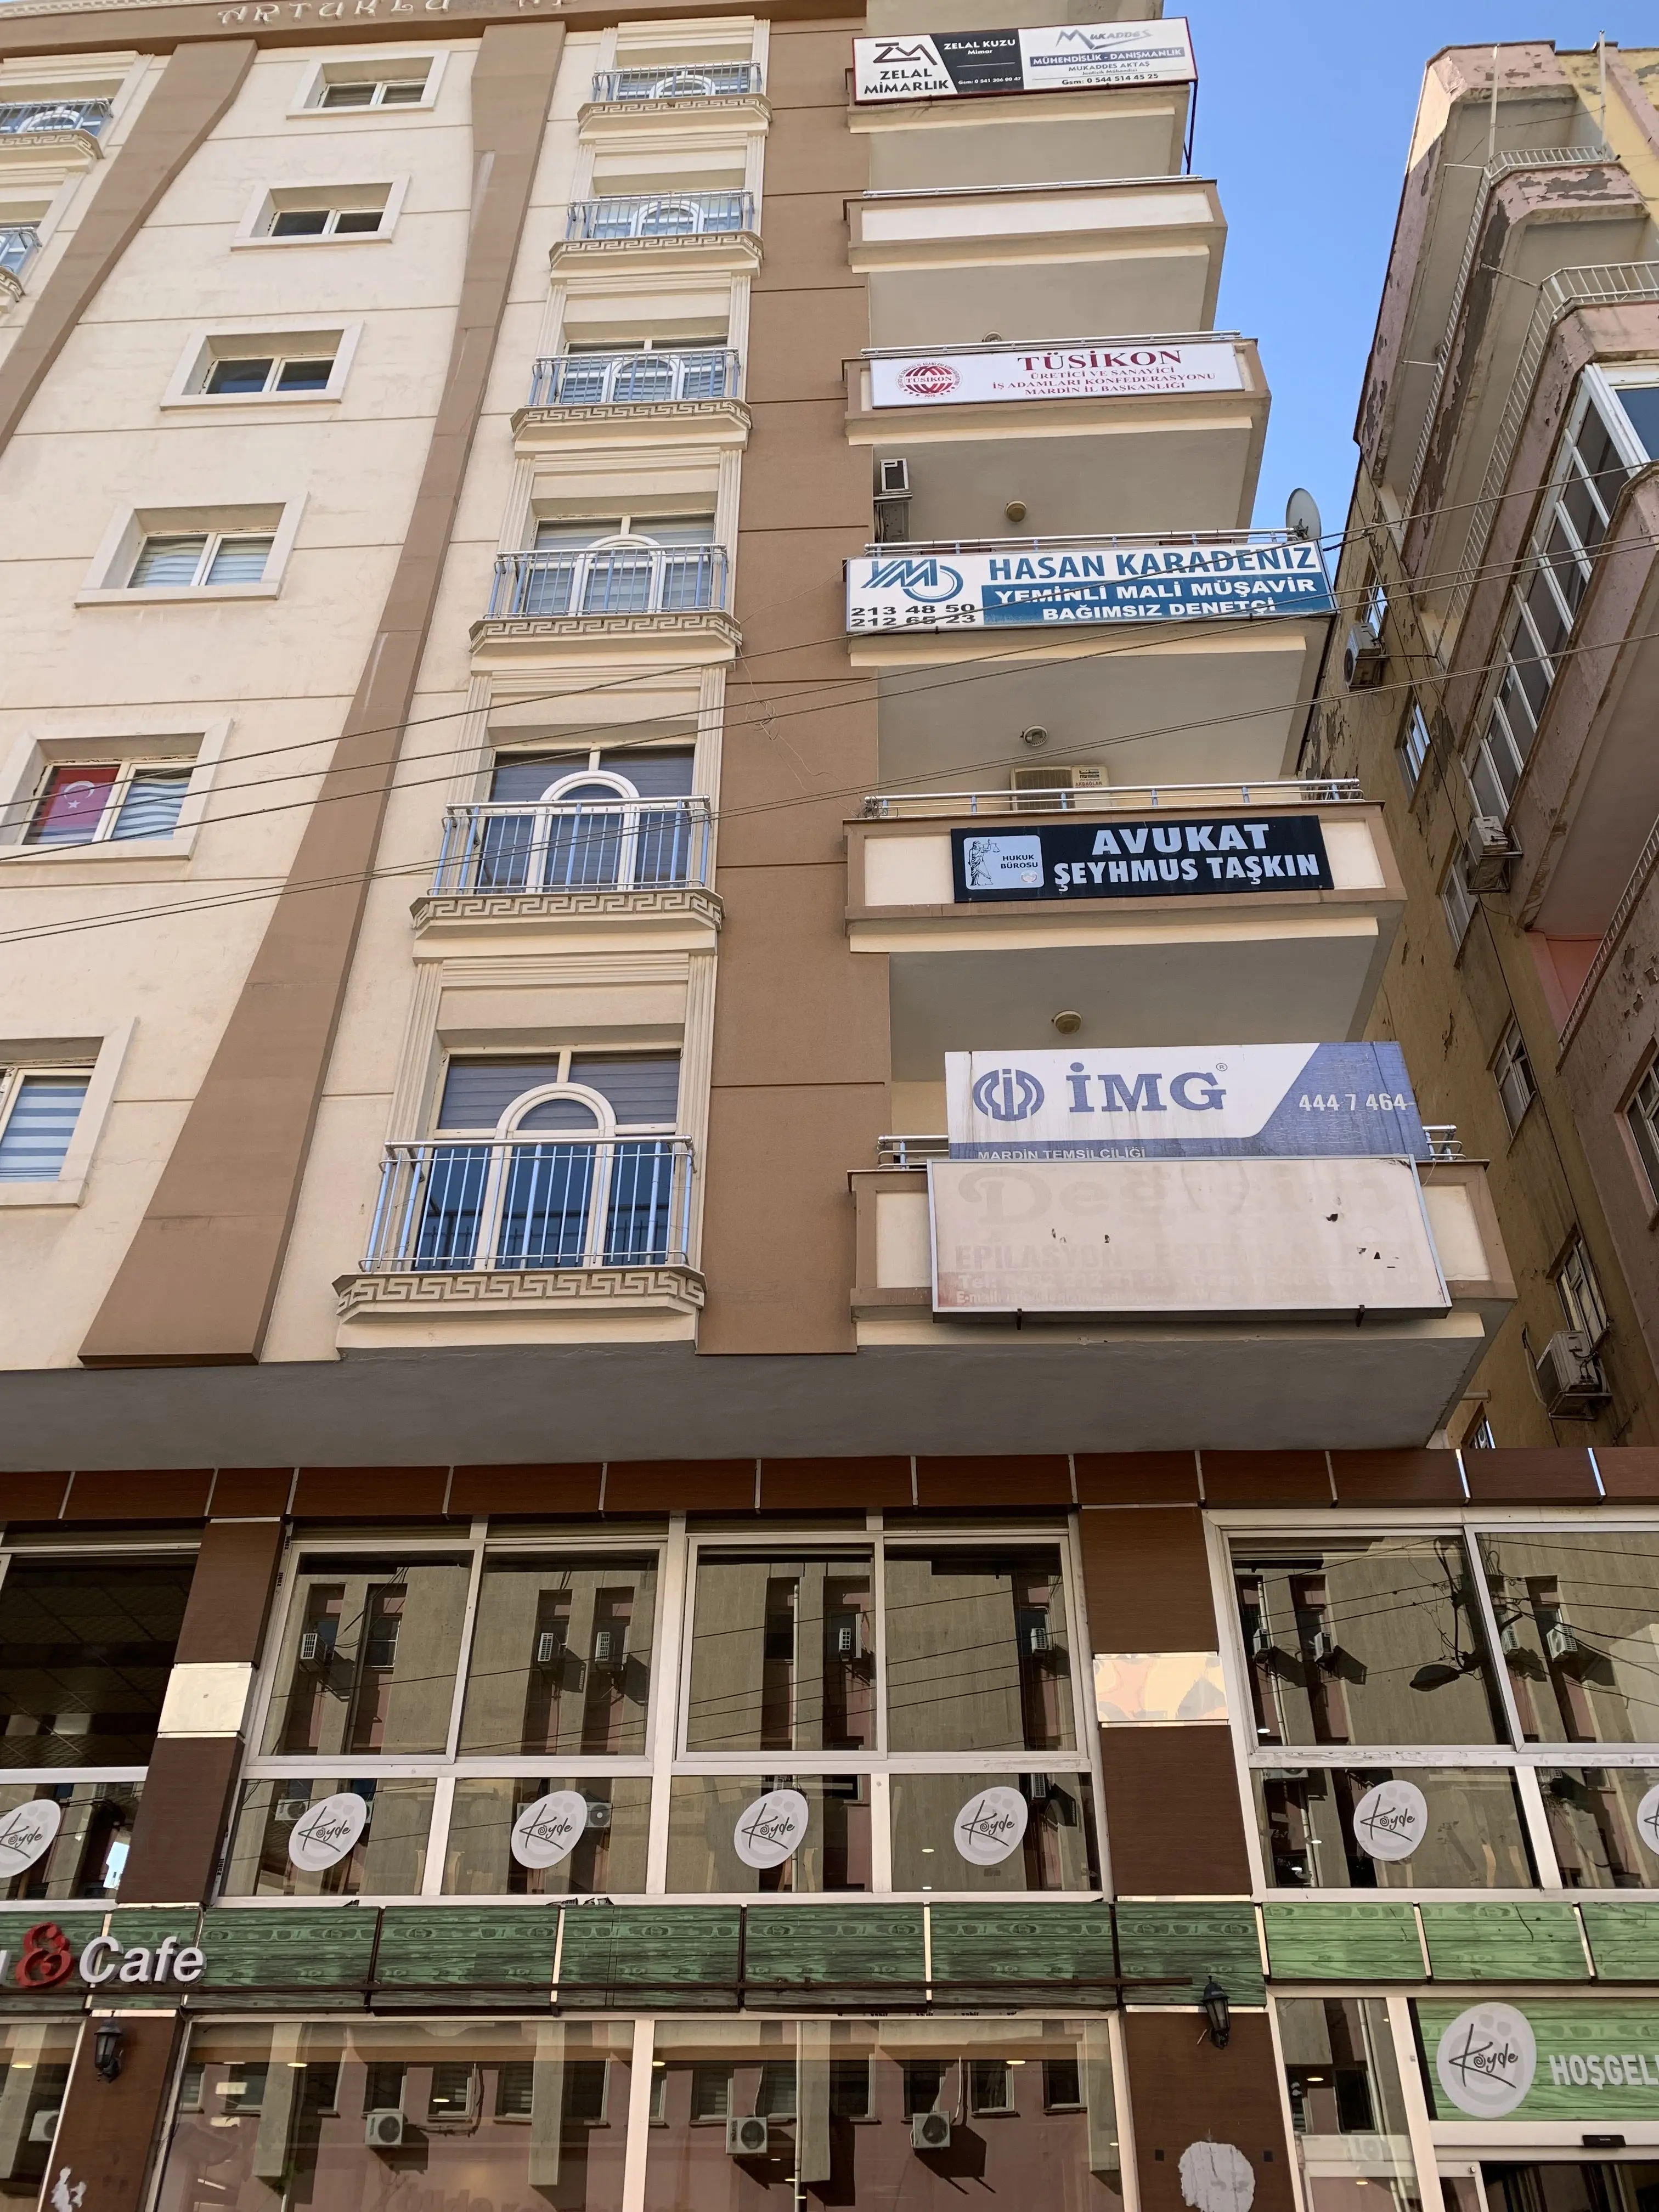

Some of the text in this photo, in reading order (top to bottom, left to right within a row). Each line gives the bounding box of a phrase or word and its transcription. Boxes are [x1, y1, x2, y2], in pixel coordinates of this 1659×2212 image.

[944, 39, 1016, 50] ZELAL KUZU
[1033, 52, 1102, 65] MÜHENDİSLİK
[1110, 48, 1182, 61] DANIŞMANLIK
[880, 68, 933, 80] ZELAL
[1069, 63, 1118, 71] MUKADDES
[864, 80, 949, 94] MİMARLIK
[1017, 350, 1181, 371] TÜSİKON
[1031, 370, 1086, 379] ÜRETİCİ
[1111, 366, 1175, 376] SANAYİCİ
[992, 373, 1216, 390] İŞ ADAMLARI KONFEDERASYONU
[1025, 386, 1080, 396] MARDİN
[1102, 382, 1186, 392] BAŞKANLIĞI
[989, 555, 1104, 580] HASAN
[995, 576, 1317, 604] YEMİNLİ MALİ MÜŞAVİR
[851, 603, 976, 616] 213 48 50
[1043, 597, 1276, 620] BAĞIMSIZ DENETÇİ
[851, 614, 977, 627] 212 65 23
[1092, 823, 1270, 856] AVUKAT
[1053, 858, 1199, 893] ŞEYHMUS
[1206, 854, 1321, 884] TAŞKIN
[1066, 1062, 1227, 1113] İMG
[1299, 1093, 1408, 1111] 444 7 464
[978, 1145, 1146, 1159] MARDİN TEMSİLCİLİĞİ
[80, 1936, 207, 1985] Cafe
[1548, 2054, 1659, 2090] HOŞGEL
